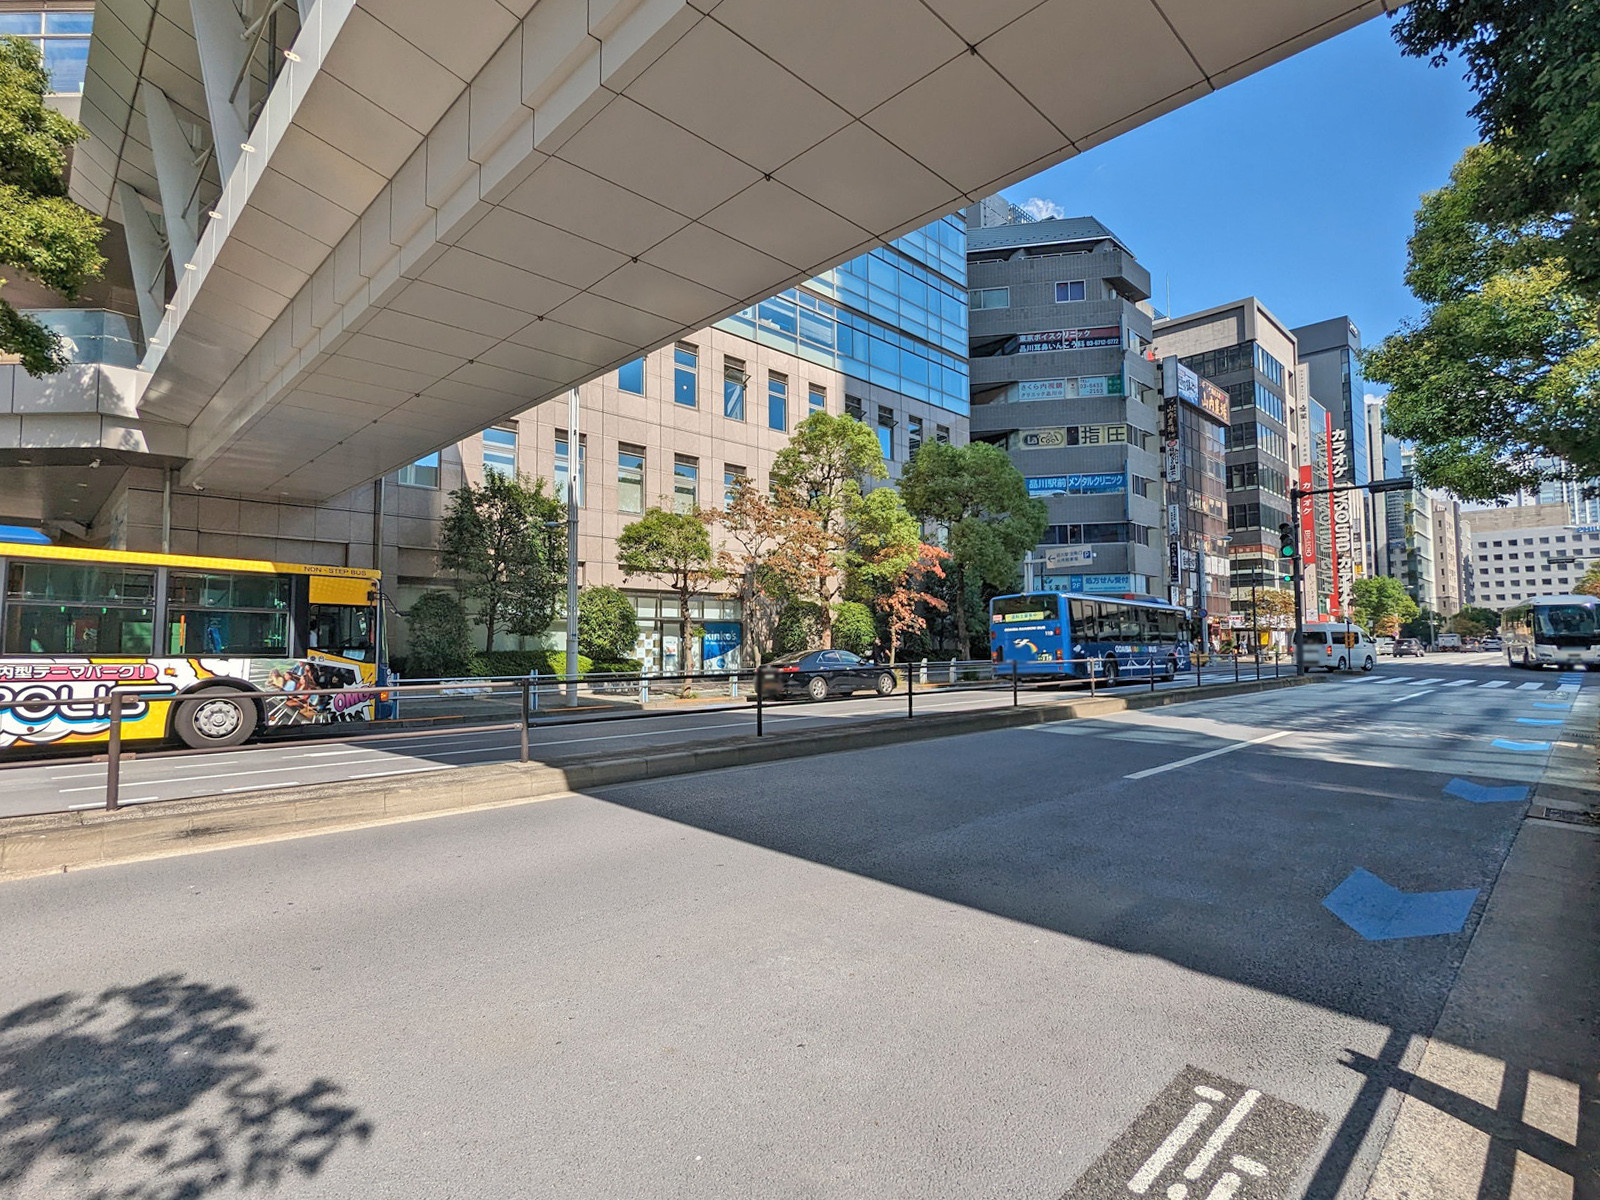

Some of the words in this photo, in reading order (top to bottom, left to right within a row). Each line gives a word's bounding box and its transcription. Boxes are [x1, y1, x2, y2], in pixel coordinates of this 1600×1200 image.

[1081, 426, 1125, 444] 指圧
[1331, 429, 1348, 478] カラオケ
[1085, 576, 1129, 585] 処方せん受付
